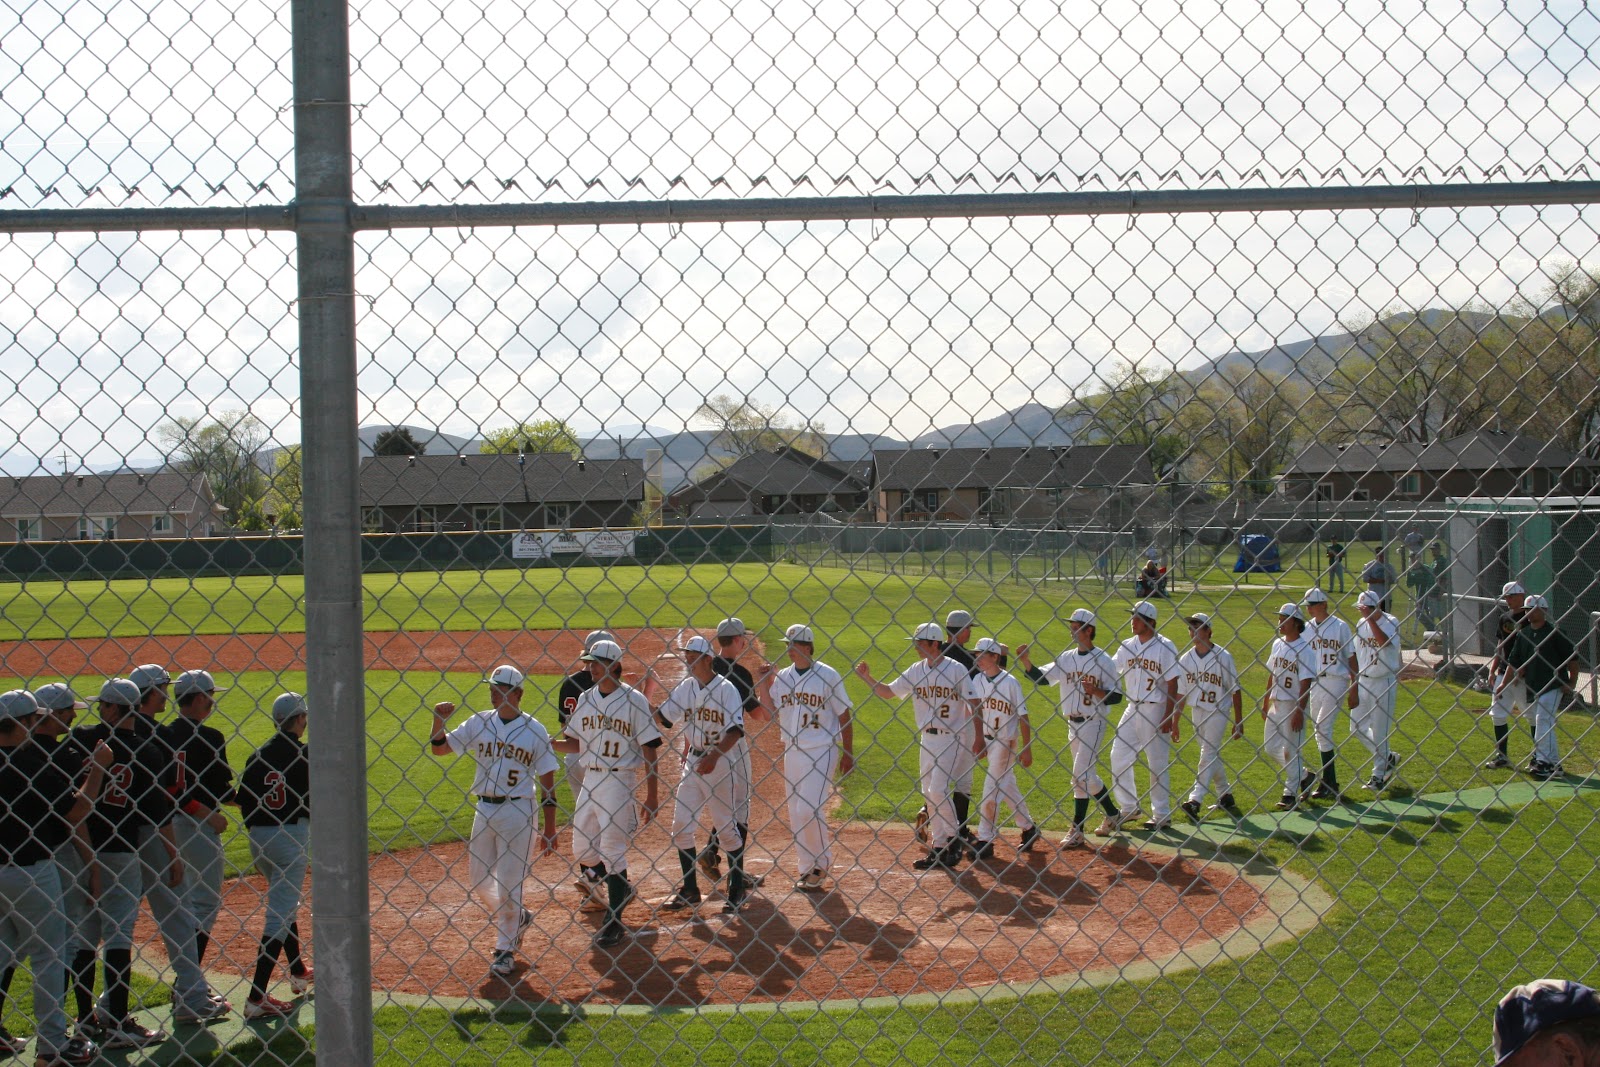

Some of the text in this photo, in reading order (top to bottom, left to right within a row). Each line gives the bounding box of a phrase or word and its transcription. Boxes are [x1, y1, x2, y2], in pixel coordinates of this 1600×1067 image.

[493, 669, 502, 678] P
[1146, 678, 1154, 691] 7
[1284, 677, 1292, 689] 6
[781, 692, 826, 710] PAYSON
[917, 685, 959, 701] PAYSON
[940, 705, 950, 719] 2
[581, 715, 632, 737] PAYSON
[801, 713, 819, 729] 14
[994, 716, 1000, 730] 1
[703, 731, 720, 746] 12
[478, 742, 534, 767] PAYSON
[601, 741, 620, 758] 11
[103, 762, 134, 808] 2
[507, 769, 520, 787] 5
[264, 770, 287, 810] 3
